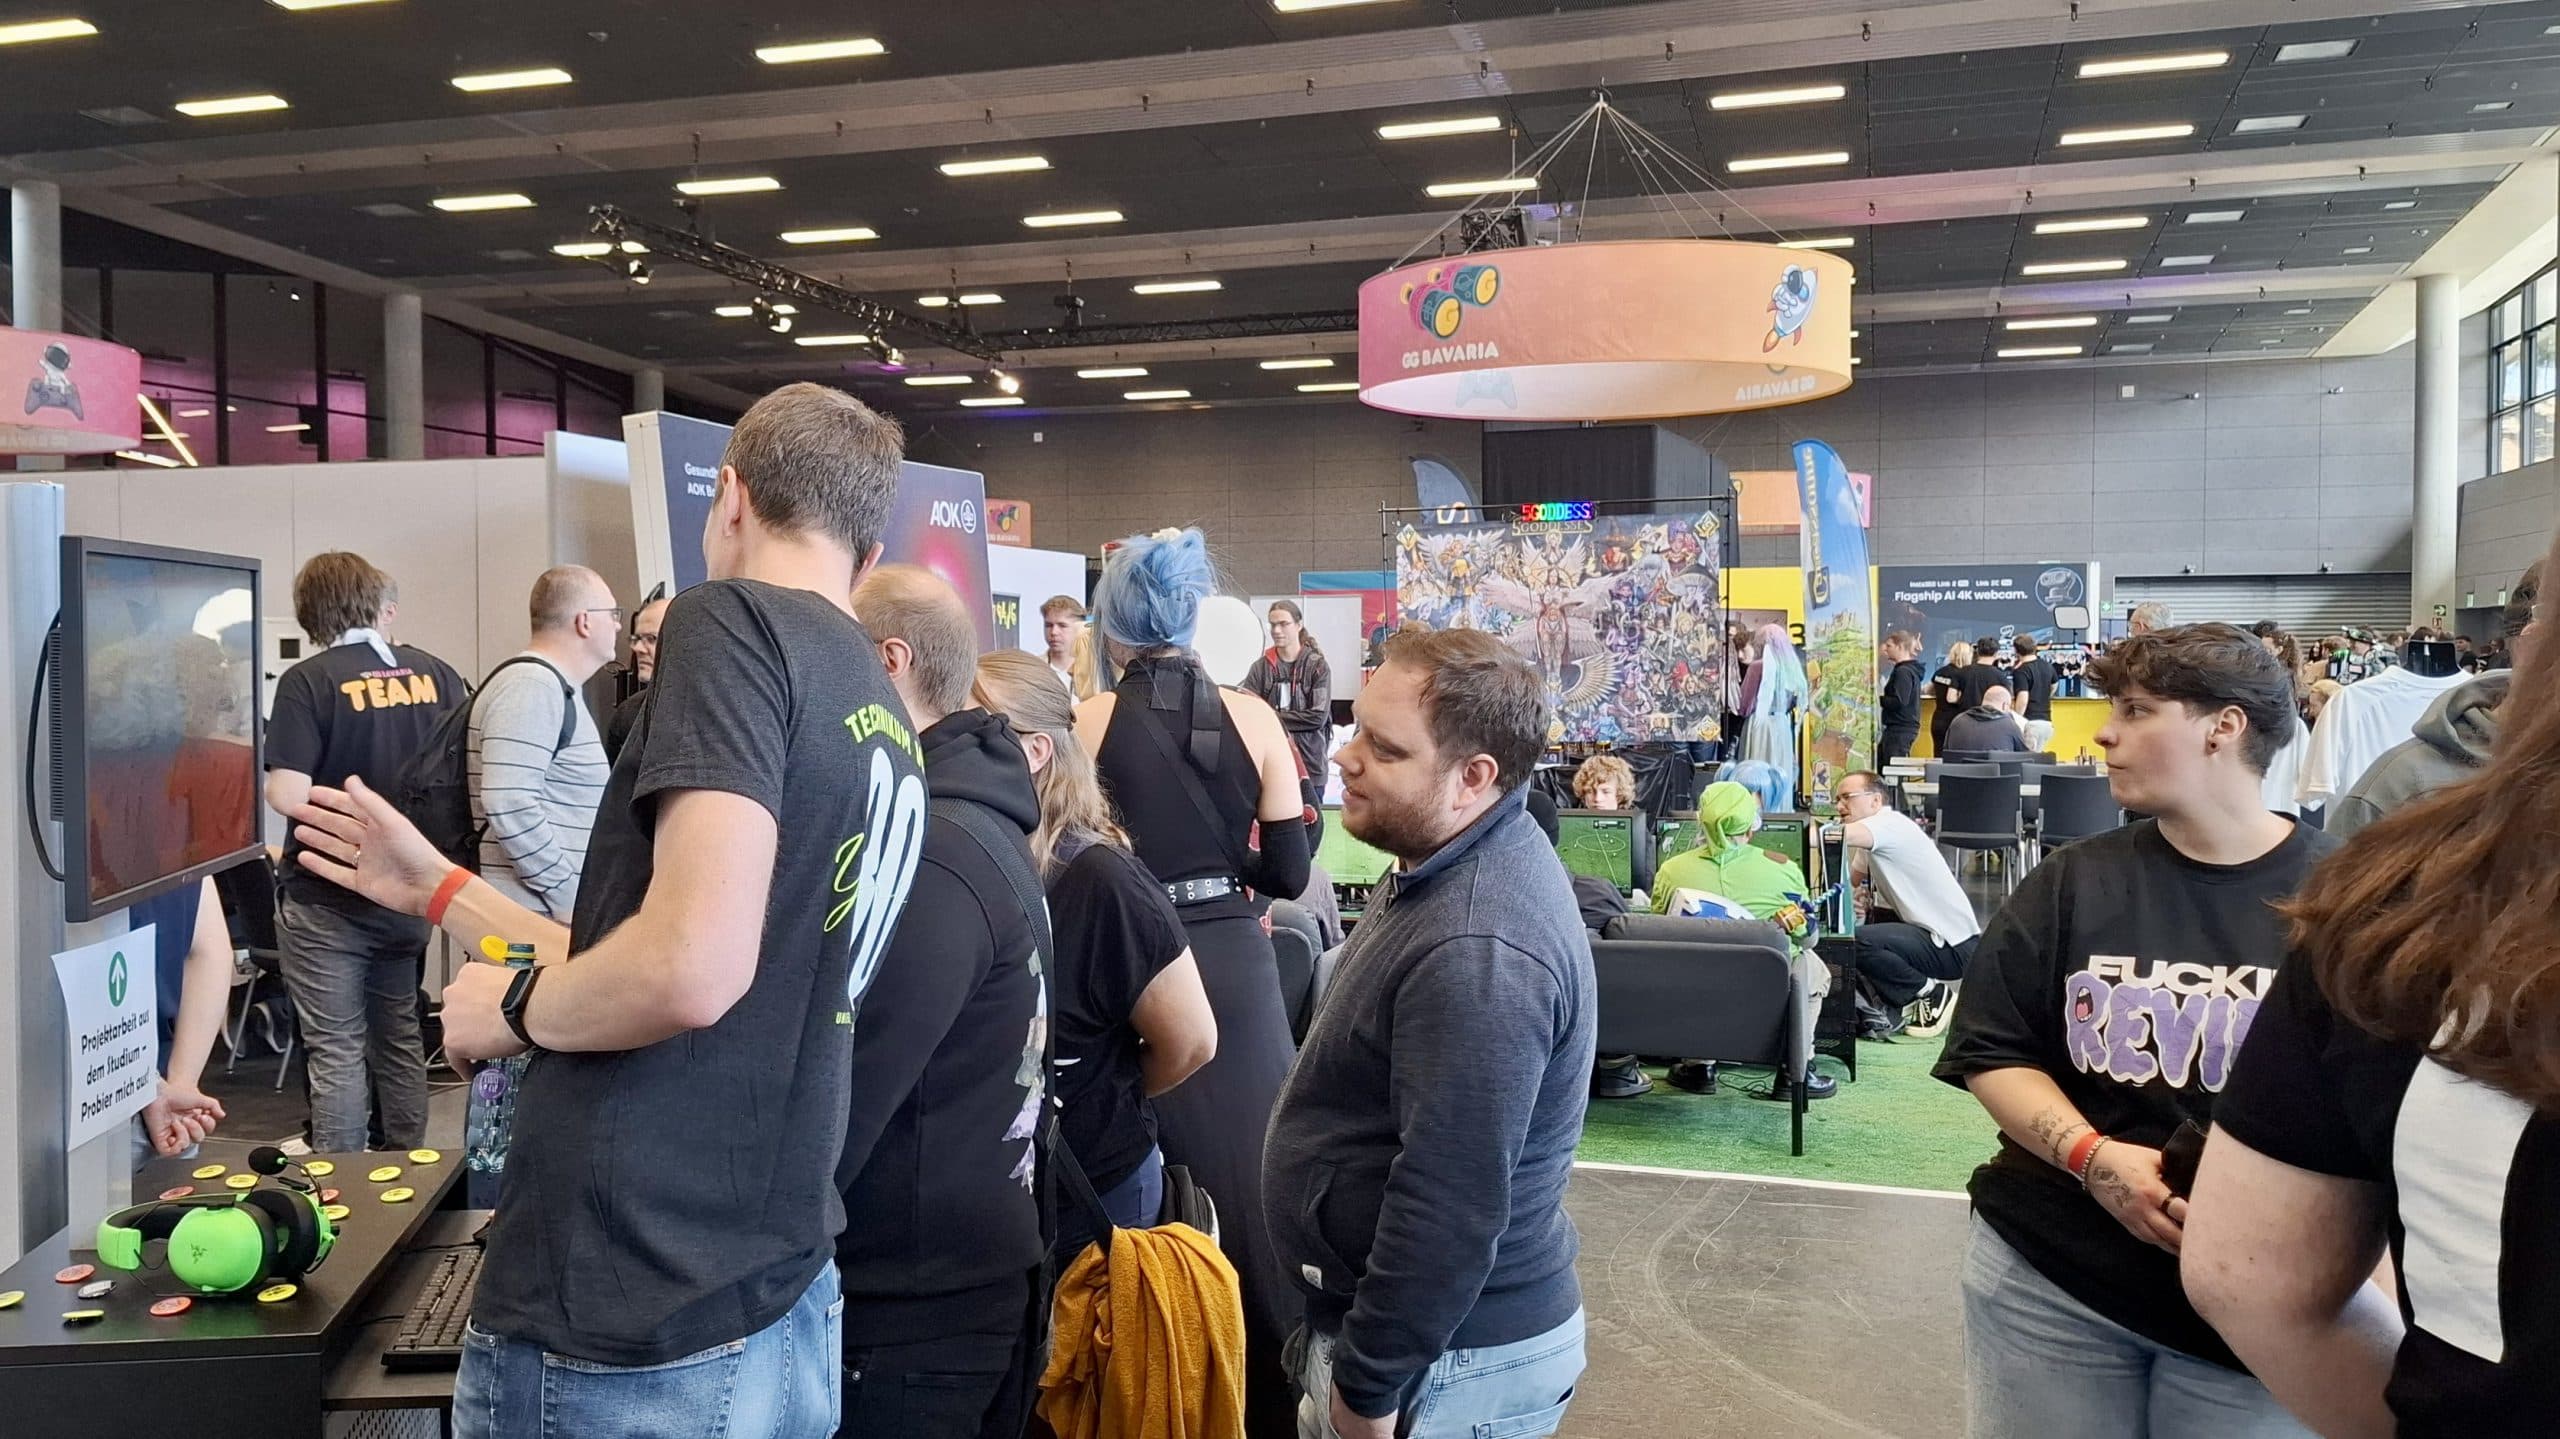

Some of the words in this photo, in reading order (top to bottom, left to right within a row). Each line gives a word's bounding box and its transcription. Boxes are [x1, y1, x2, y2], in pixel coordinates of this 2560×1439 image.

[1402, 351, 1420, 369] GG
[1422, 341, 1499, 366] BAVARIA
[687, 482, 706, 497] AOK
[930, 500, 962, 528] AOK
[1895, 590, 1942, 603] Flagship
[1944, 591, 1956, 600] AI
[1957, 591, 1972, 600] 4K
[1973, 589, 2028, 600] webcam.
[341, 674, 438, 712] TEAM
[2088, 954, 2278, 1001] FUCKI
[81, 1012, 137, 1055] Projektarbeit
[139, 1010, 150, 1027] aus
[86, 1064, 105, 1085] dem
[107, 1047, 140, 1075] Studium
[81, 1091, 112, 1123] Probier
[115, 1076, 134, 1103] mich
